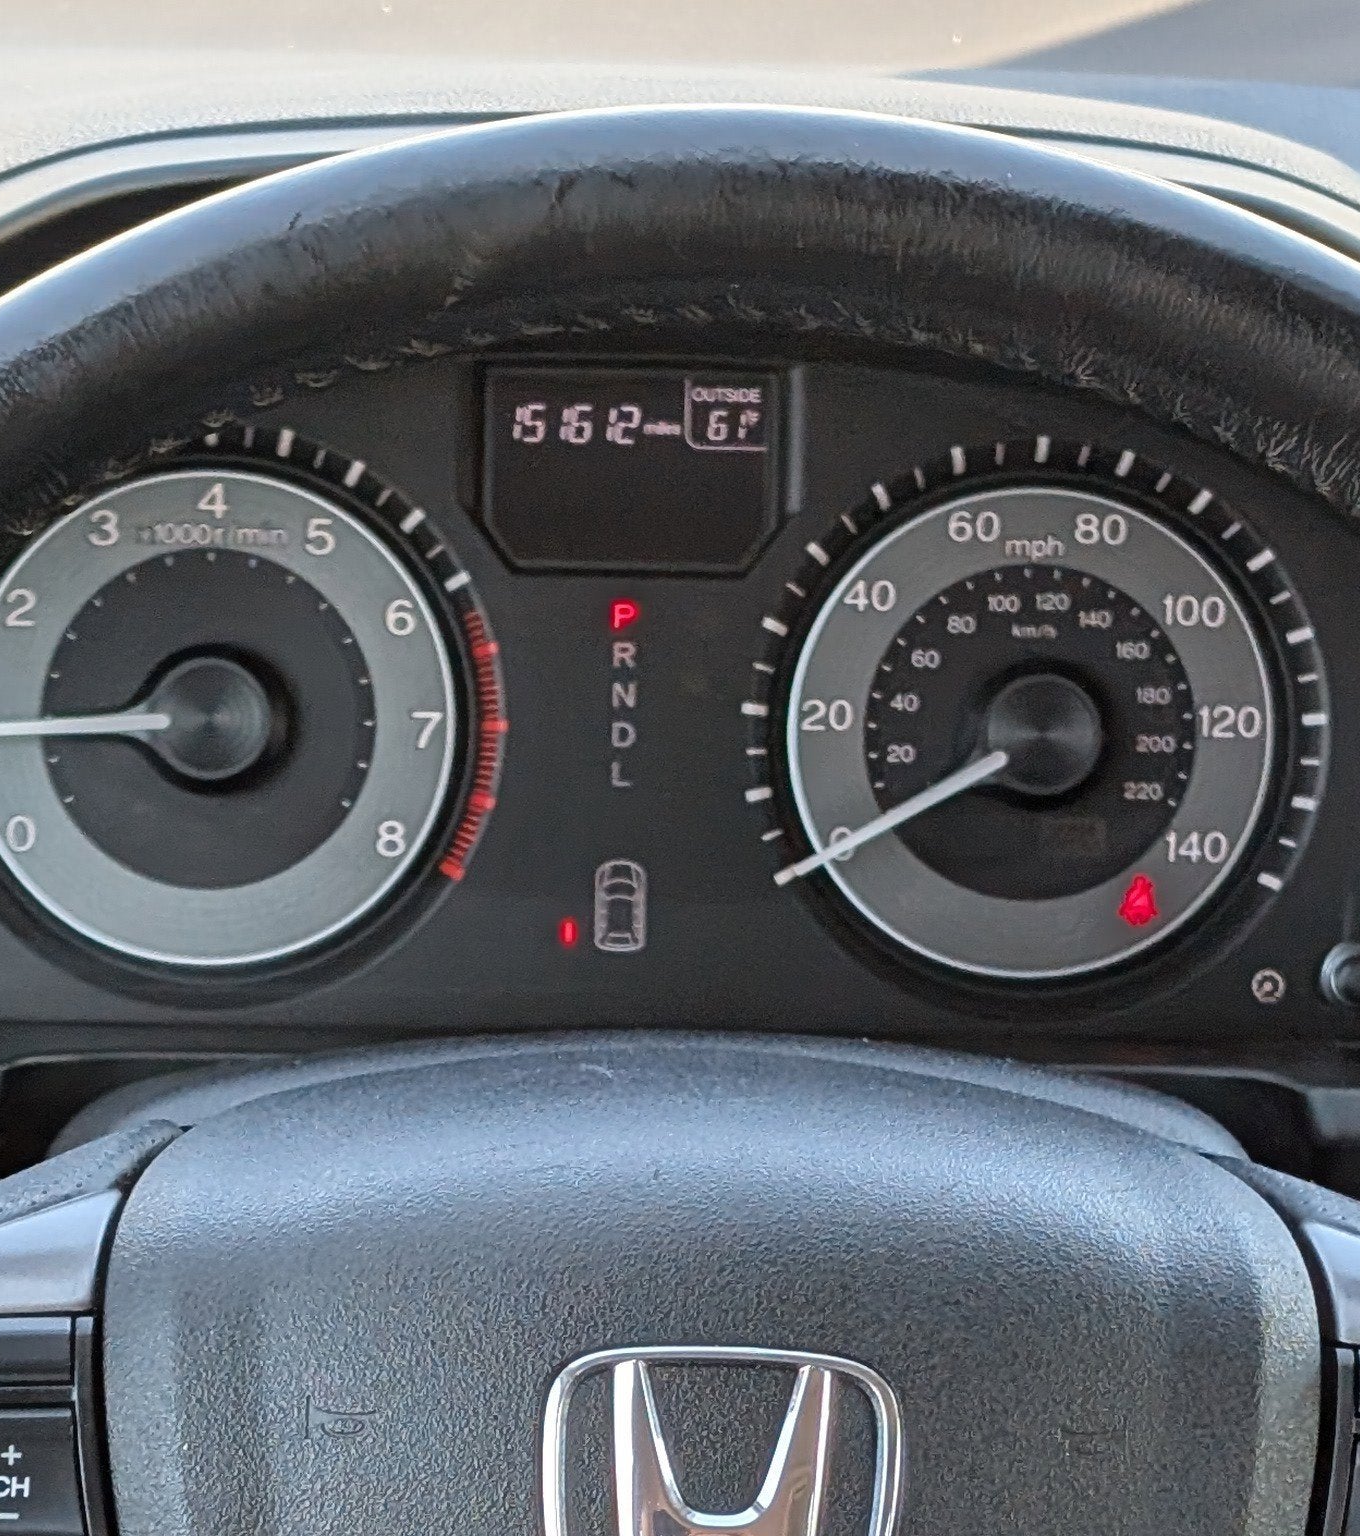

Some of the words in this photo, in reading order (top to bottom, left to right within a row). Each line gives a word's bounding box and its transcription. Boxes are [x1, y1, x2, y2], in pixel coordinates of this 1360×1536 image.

[691, 387, 762, 404] OUTSIDE
[197, 483, 228, 519] 4
[88, 511, 120, 546] 3
[304, 518, 336, 556] 5
[946, 510, 1000, 543] 60
[1073, 514, 1129, 547] 80
[1004, 533, 1065, 562] mph
[4, 588, 36, 627] 2
[842, 579, 897, 613] 40
[987, 594, 1021, 613] 100
[1034, 592, 1070, 612] 120
[1162, 594, 1227, 629] 100
[384, 599, 414, 636] 6
[613, 603, 637, 629] P
[946, 614, 977, 635] 80
[611, 641, 637, 669] R
[910, 649, 941, 669] 60
[611, 681, 637, 709] N
[889, 693, 921, 713] 40
[409, 710, 443, 750] 7
[800, 698, 854, 732] 20
[1198, 704, 1262, 739] 120
[611, 720, 637, 749] D
[886, 744, 916, 764] 20
[611, 761, 634, 788] L
[5, 815, 37, 852] 0
[375, 820, 406, 858] 8
[1164, 829, 1229, 864] 140
